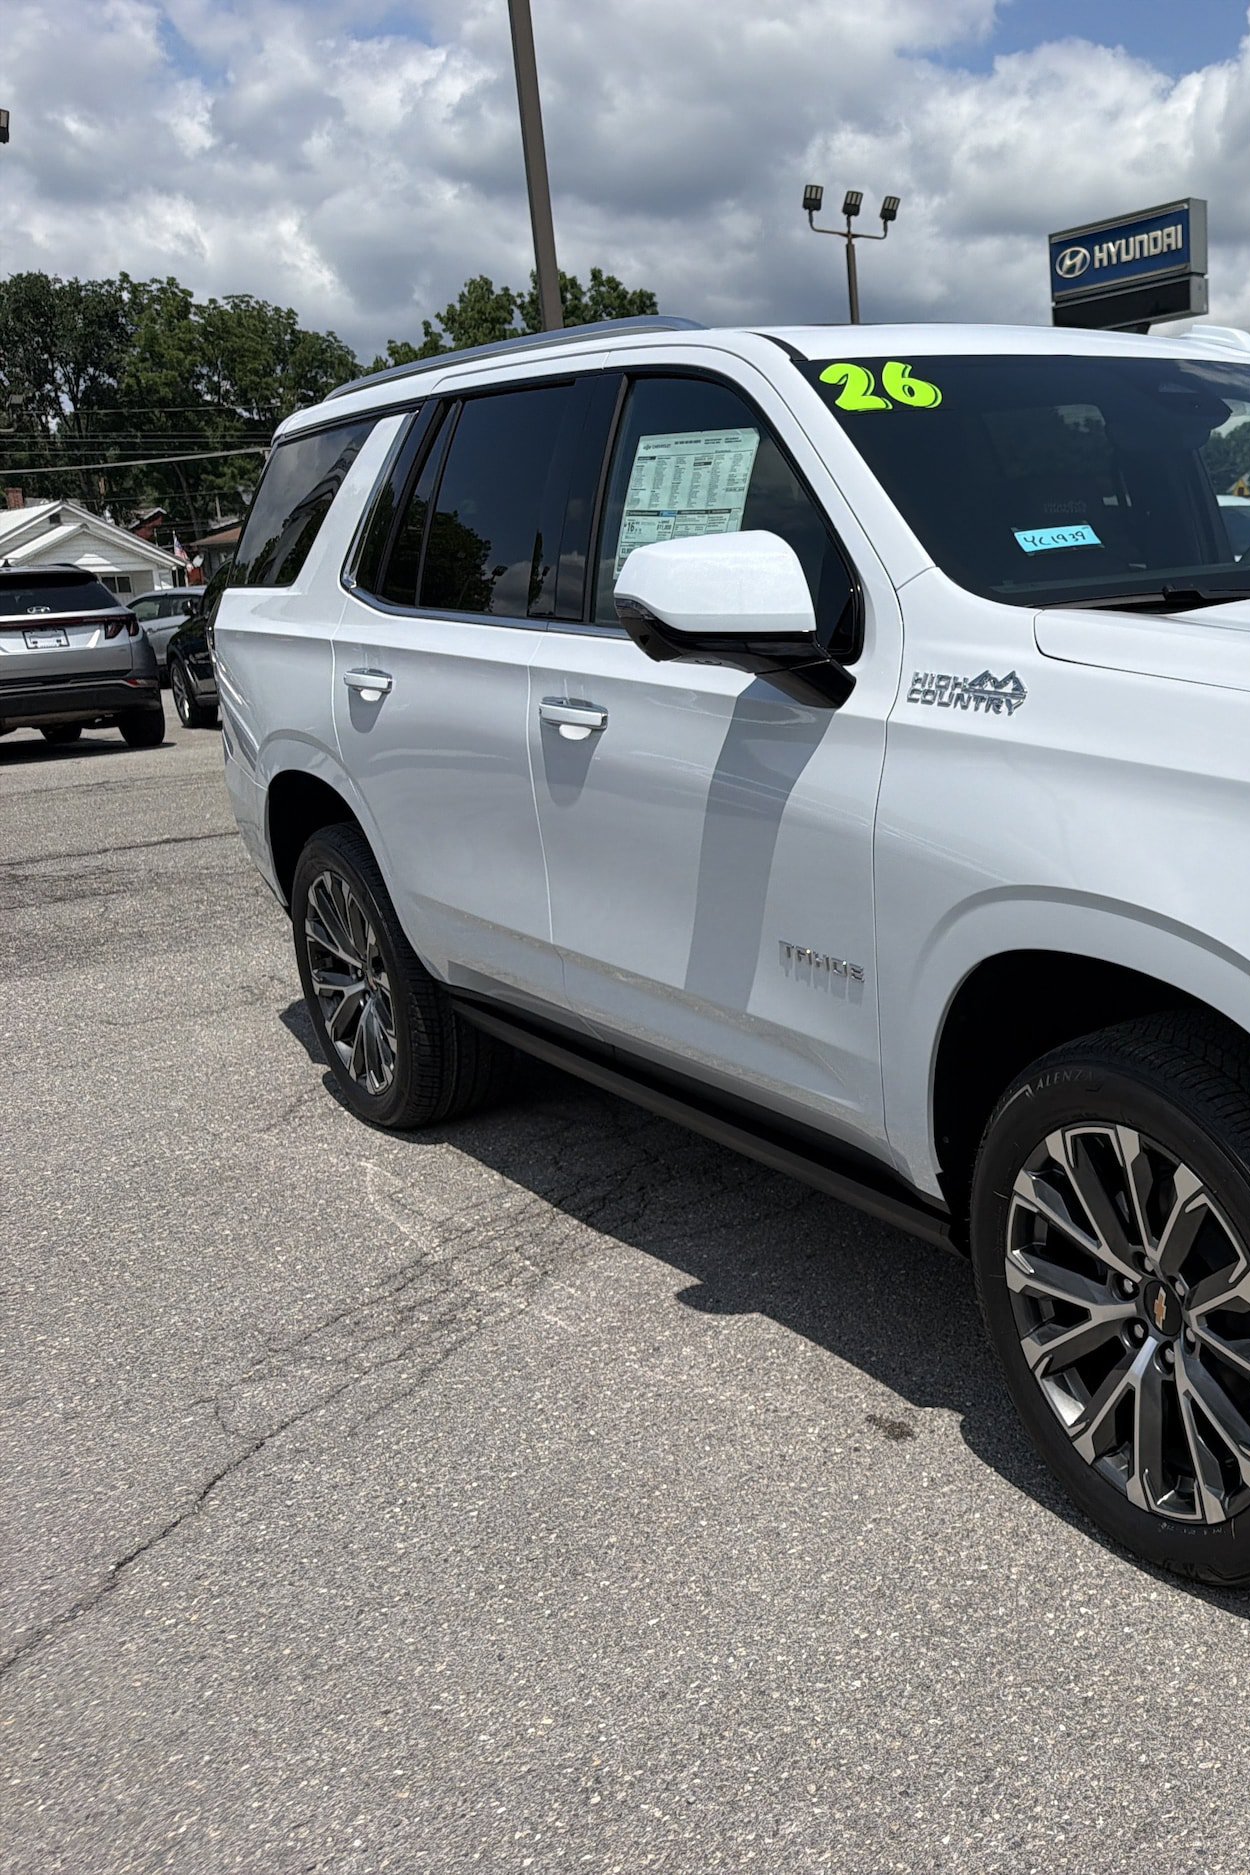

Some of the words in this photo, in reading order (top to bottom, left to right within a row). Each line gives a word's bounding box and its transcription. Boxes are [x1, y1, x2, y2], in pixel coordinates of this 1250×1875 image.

[1093, 223, 1183, 269] HYUNDAI
[818, 361, 943, 411] 26
[1023, 531, 1086, 547] YC1939
[911, 671, 969, 691] HIGH
[906, 687, 1025, 716] COUNTRY
[778, 940, 865, 983] TAHOE
